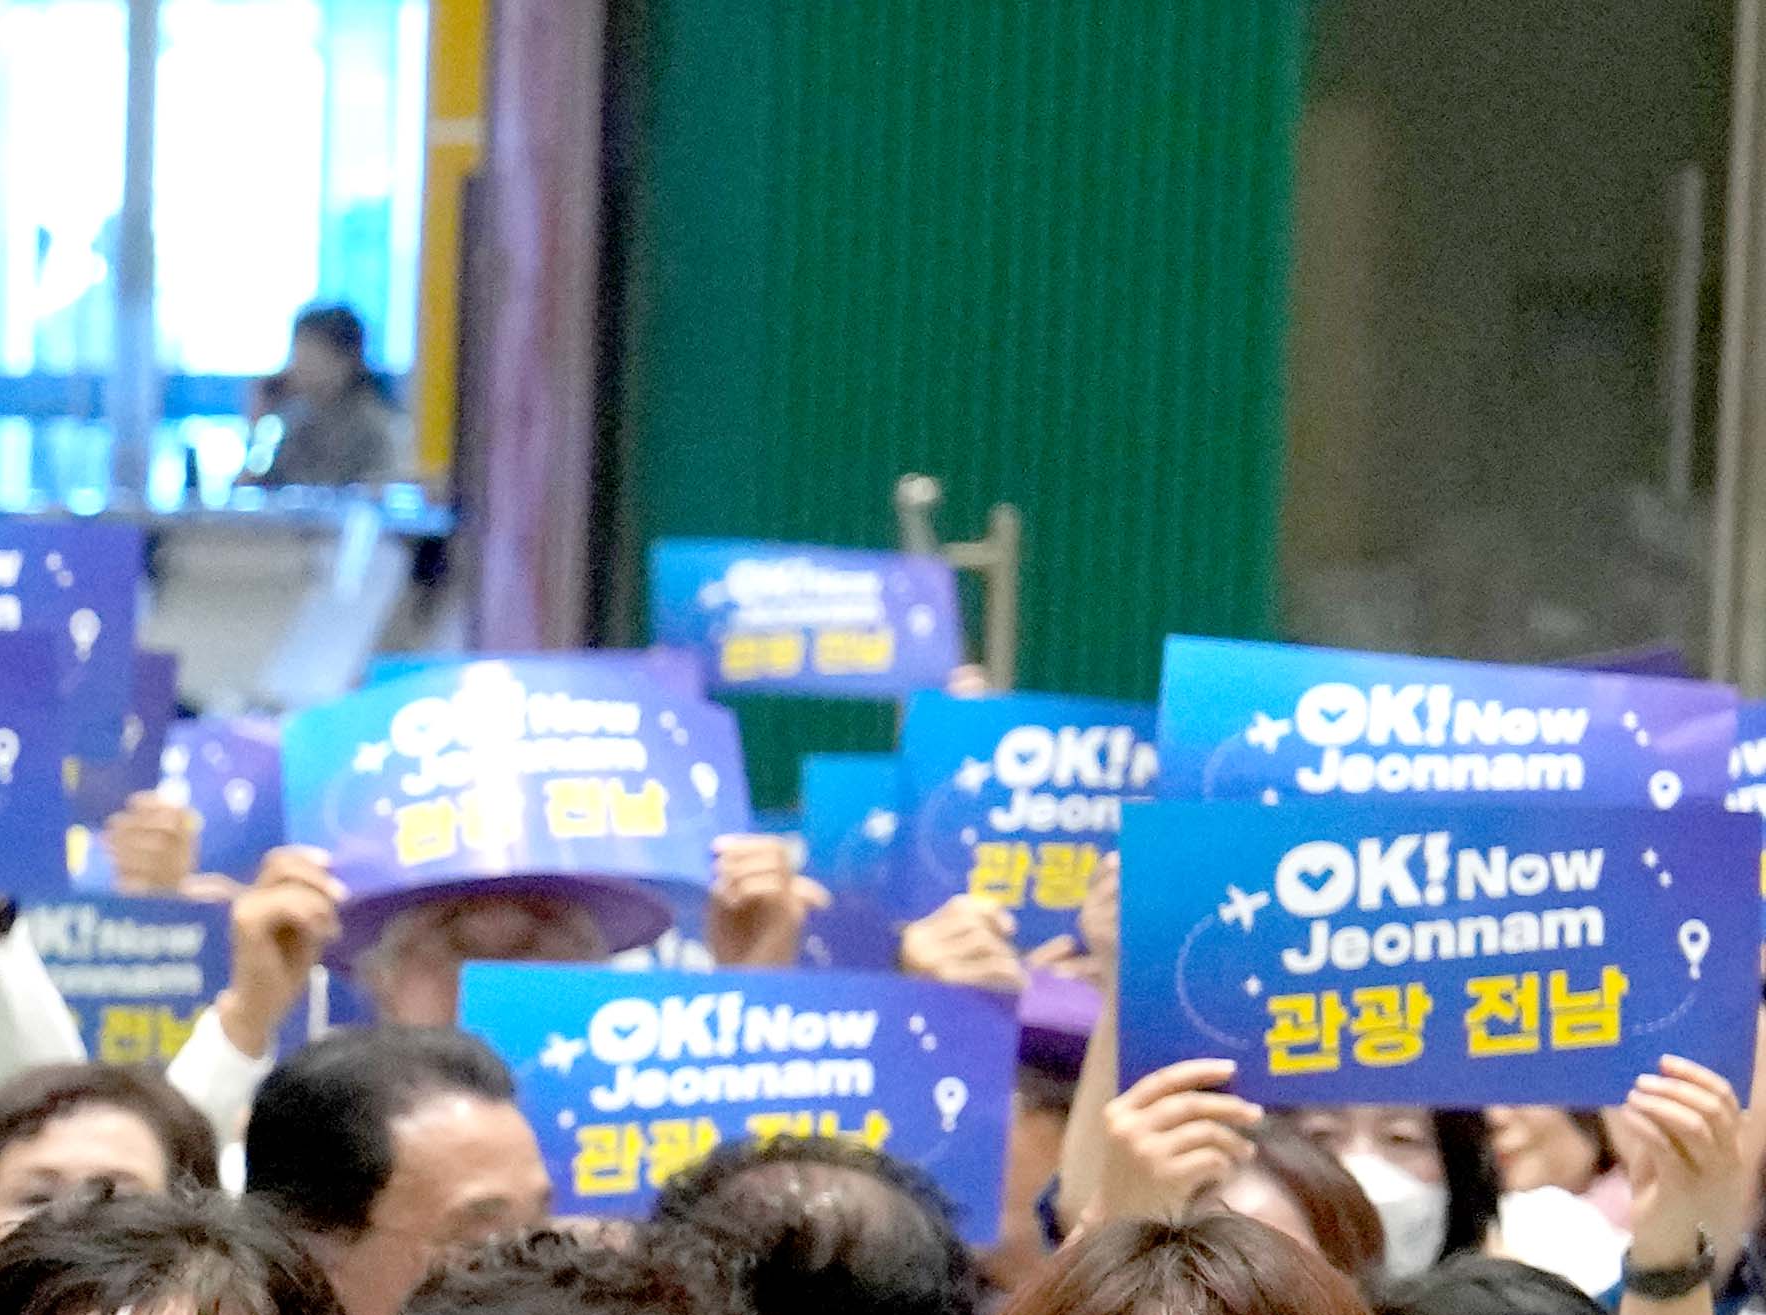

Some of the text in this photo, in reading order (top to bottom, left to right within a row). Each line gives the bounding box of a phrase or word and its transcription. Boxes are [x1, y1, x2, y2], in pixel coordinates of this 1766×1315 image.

[1296, 682, 1589, 748] OK! Now
[992, 725, 1133, 791] OK!
[1296, 746, 1585, 793] Jeonnam
[1275, 832, 1606, 918] OK! Now
[1281, 905, 1606, 976] Jeonnam
[589, 990, 879, 1065] OK! Now
[1264, 964, 1630, 1078] 관광 전남
[590, 1058, 875, 1112] Jeonnam
